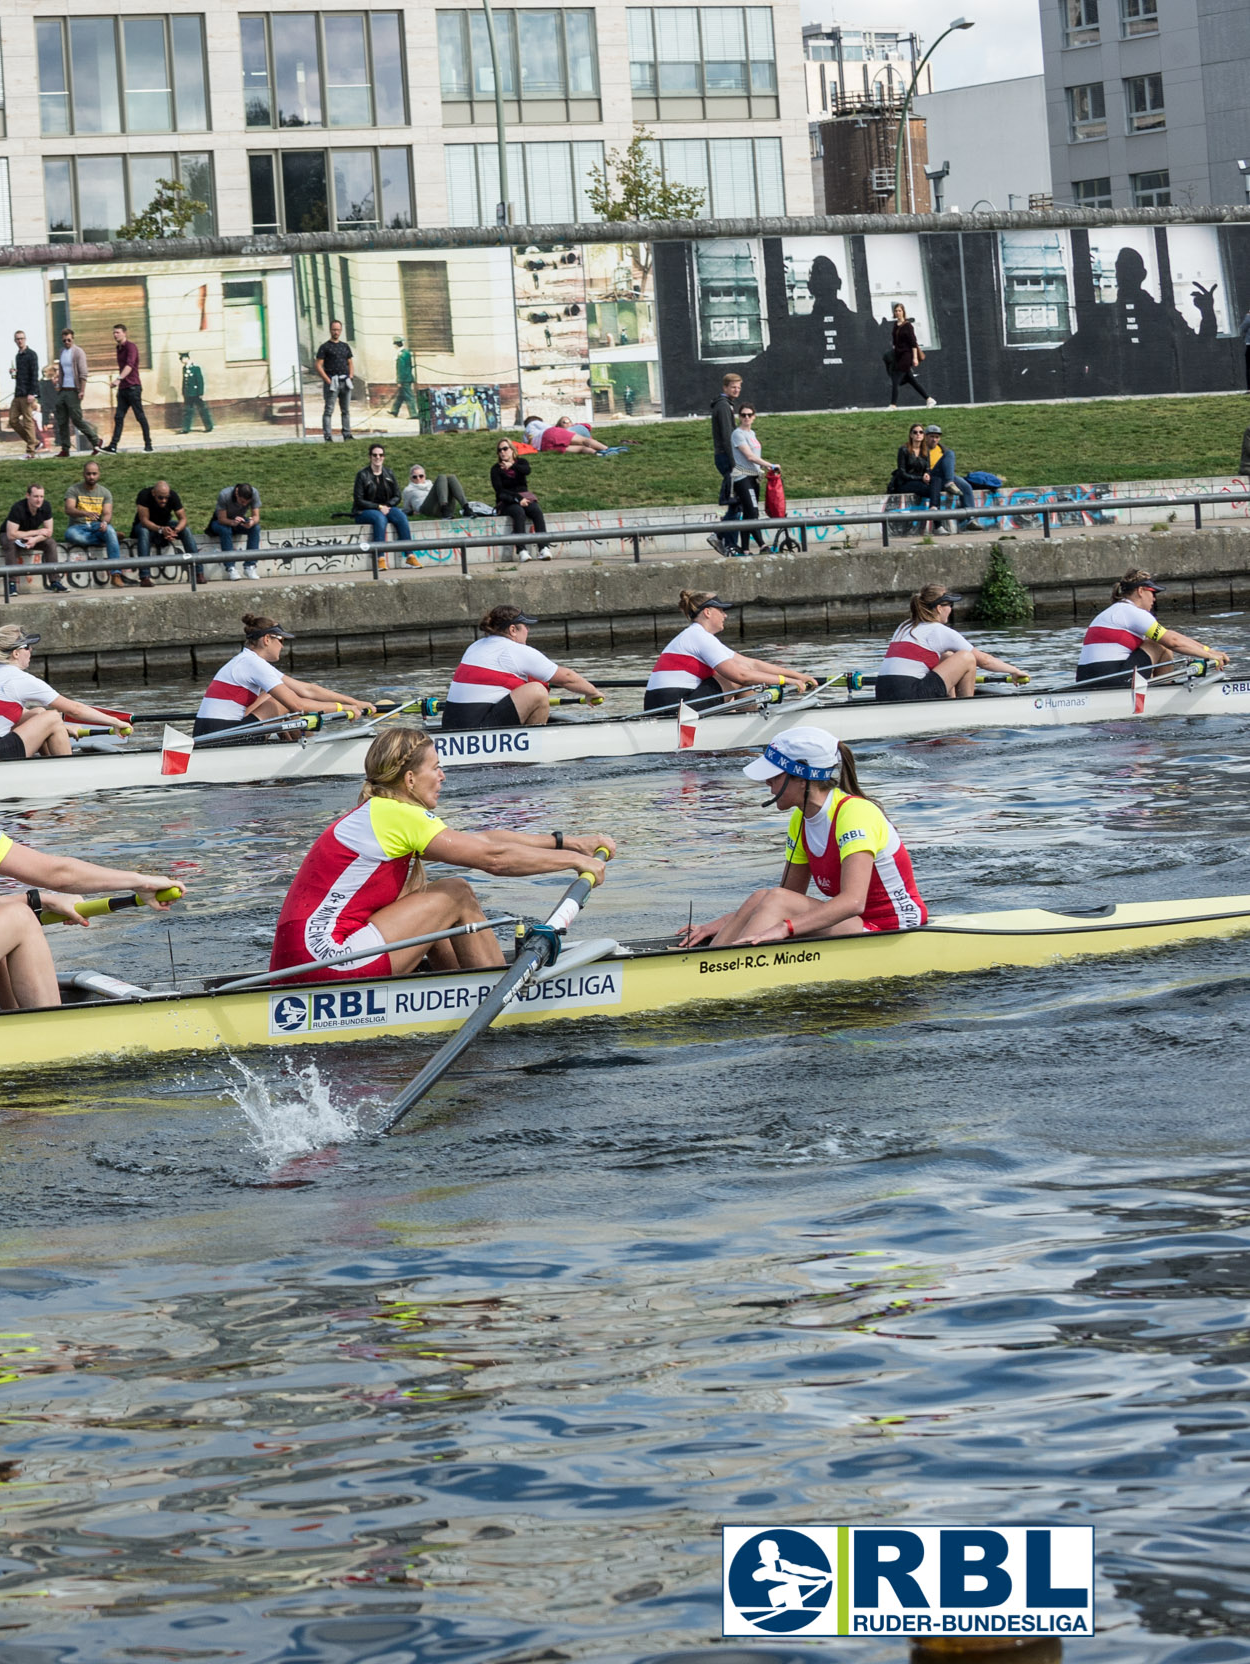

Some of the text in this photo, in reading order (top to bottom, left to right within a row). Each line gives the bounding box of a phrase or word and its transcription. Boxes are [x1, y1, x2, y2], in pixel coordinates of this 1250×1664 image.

[1045, 698, 1086, 709] Humanas
[434, 732, 530, 757] RNBURG
[330, 892, 346, 904] 8+
[699, 950, 821, 974] Bessel-R.C. Minden
[313, 989, 386, 1021] RBL
[312, 1015, 386, 1029] RUDER-BUNDESLIGA
